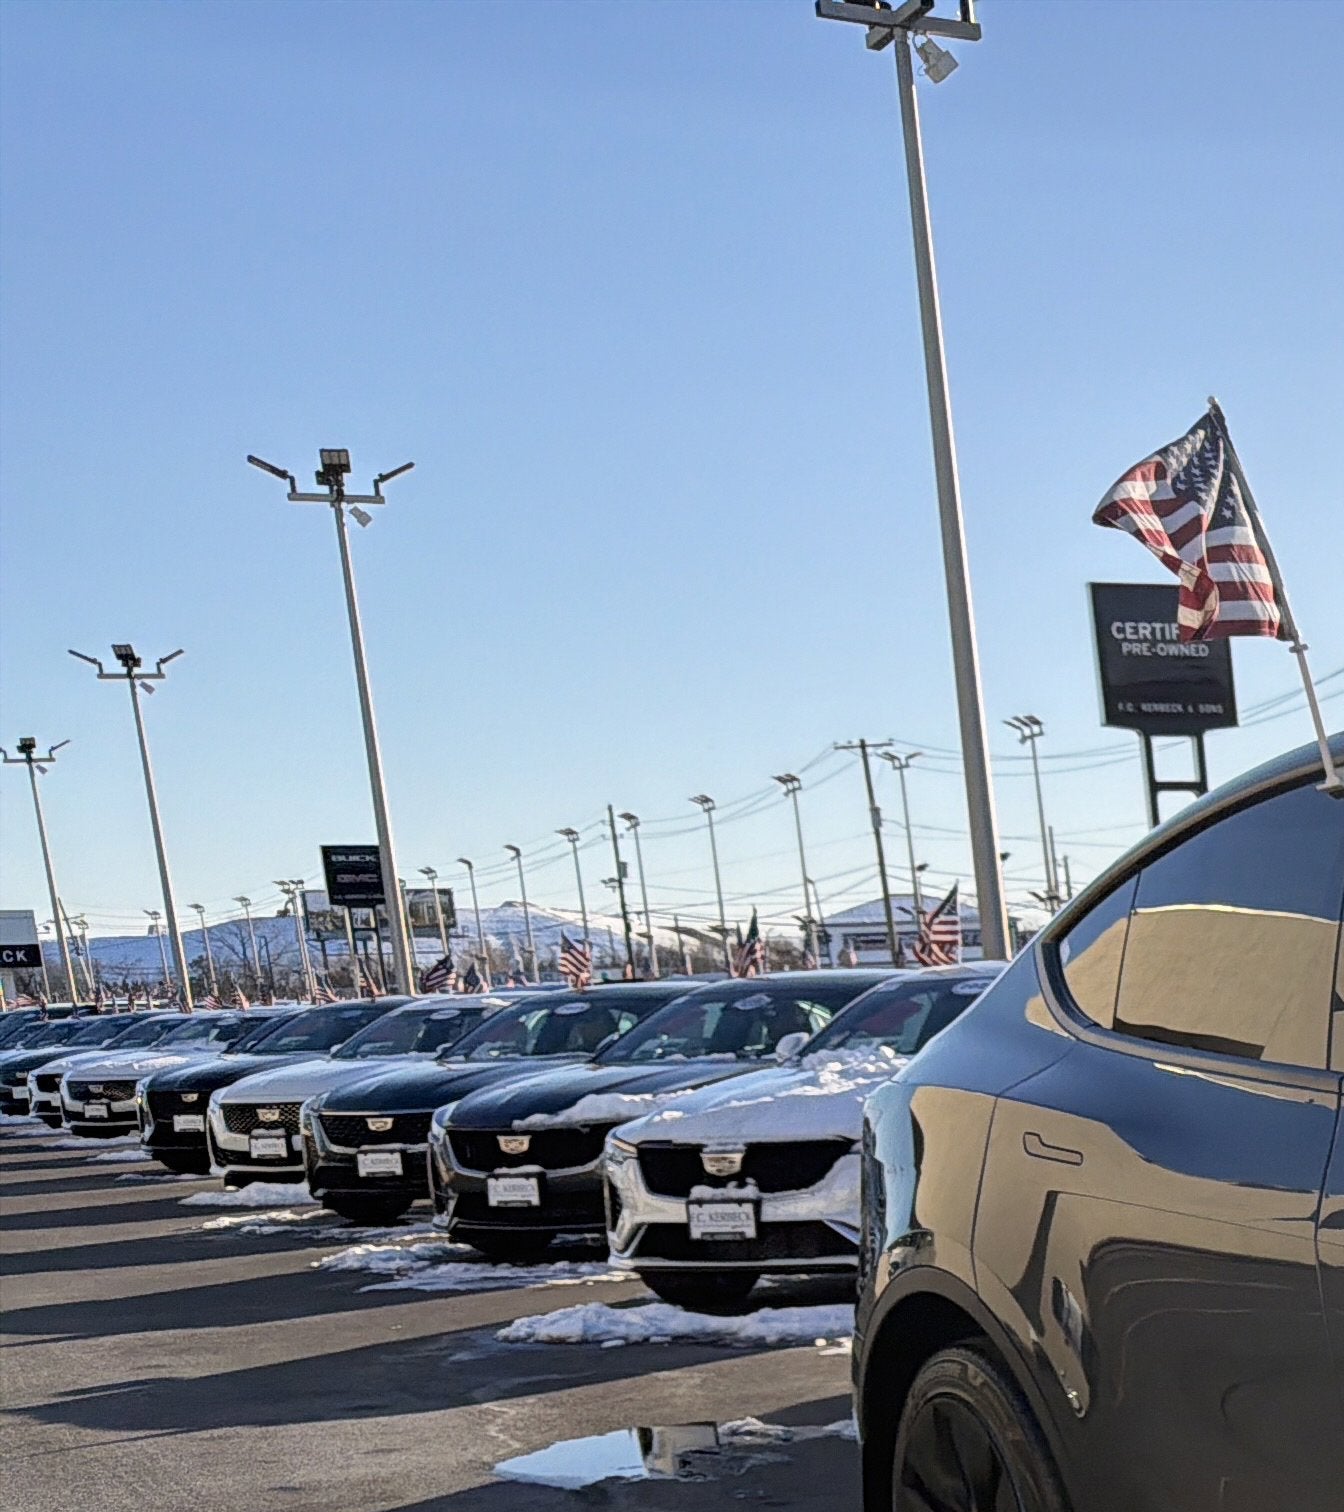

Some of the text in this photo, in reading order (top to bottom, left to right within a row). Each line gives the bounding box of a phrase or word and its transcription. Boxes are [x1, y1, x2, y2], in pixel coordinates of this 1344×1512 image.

[1111, 621, 1181, 641] CERTIF
[1121, 642, 1210, 657] PRE-OWNED
[331, 854, 377, 862] BUICK
